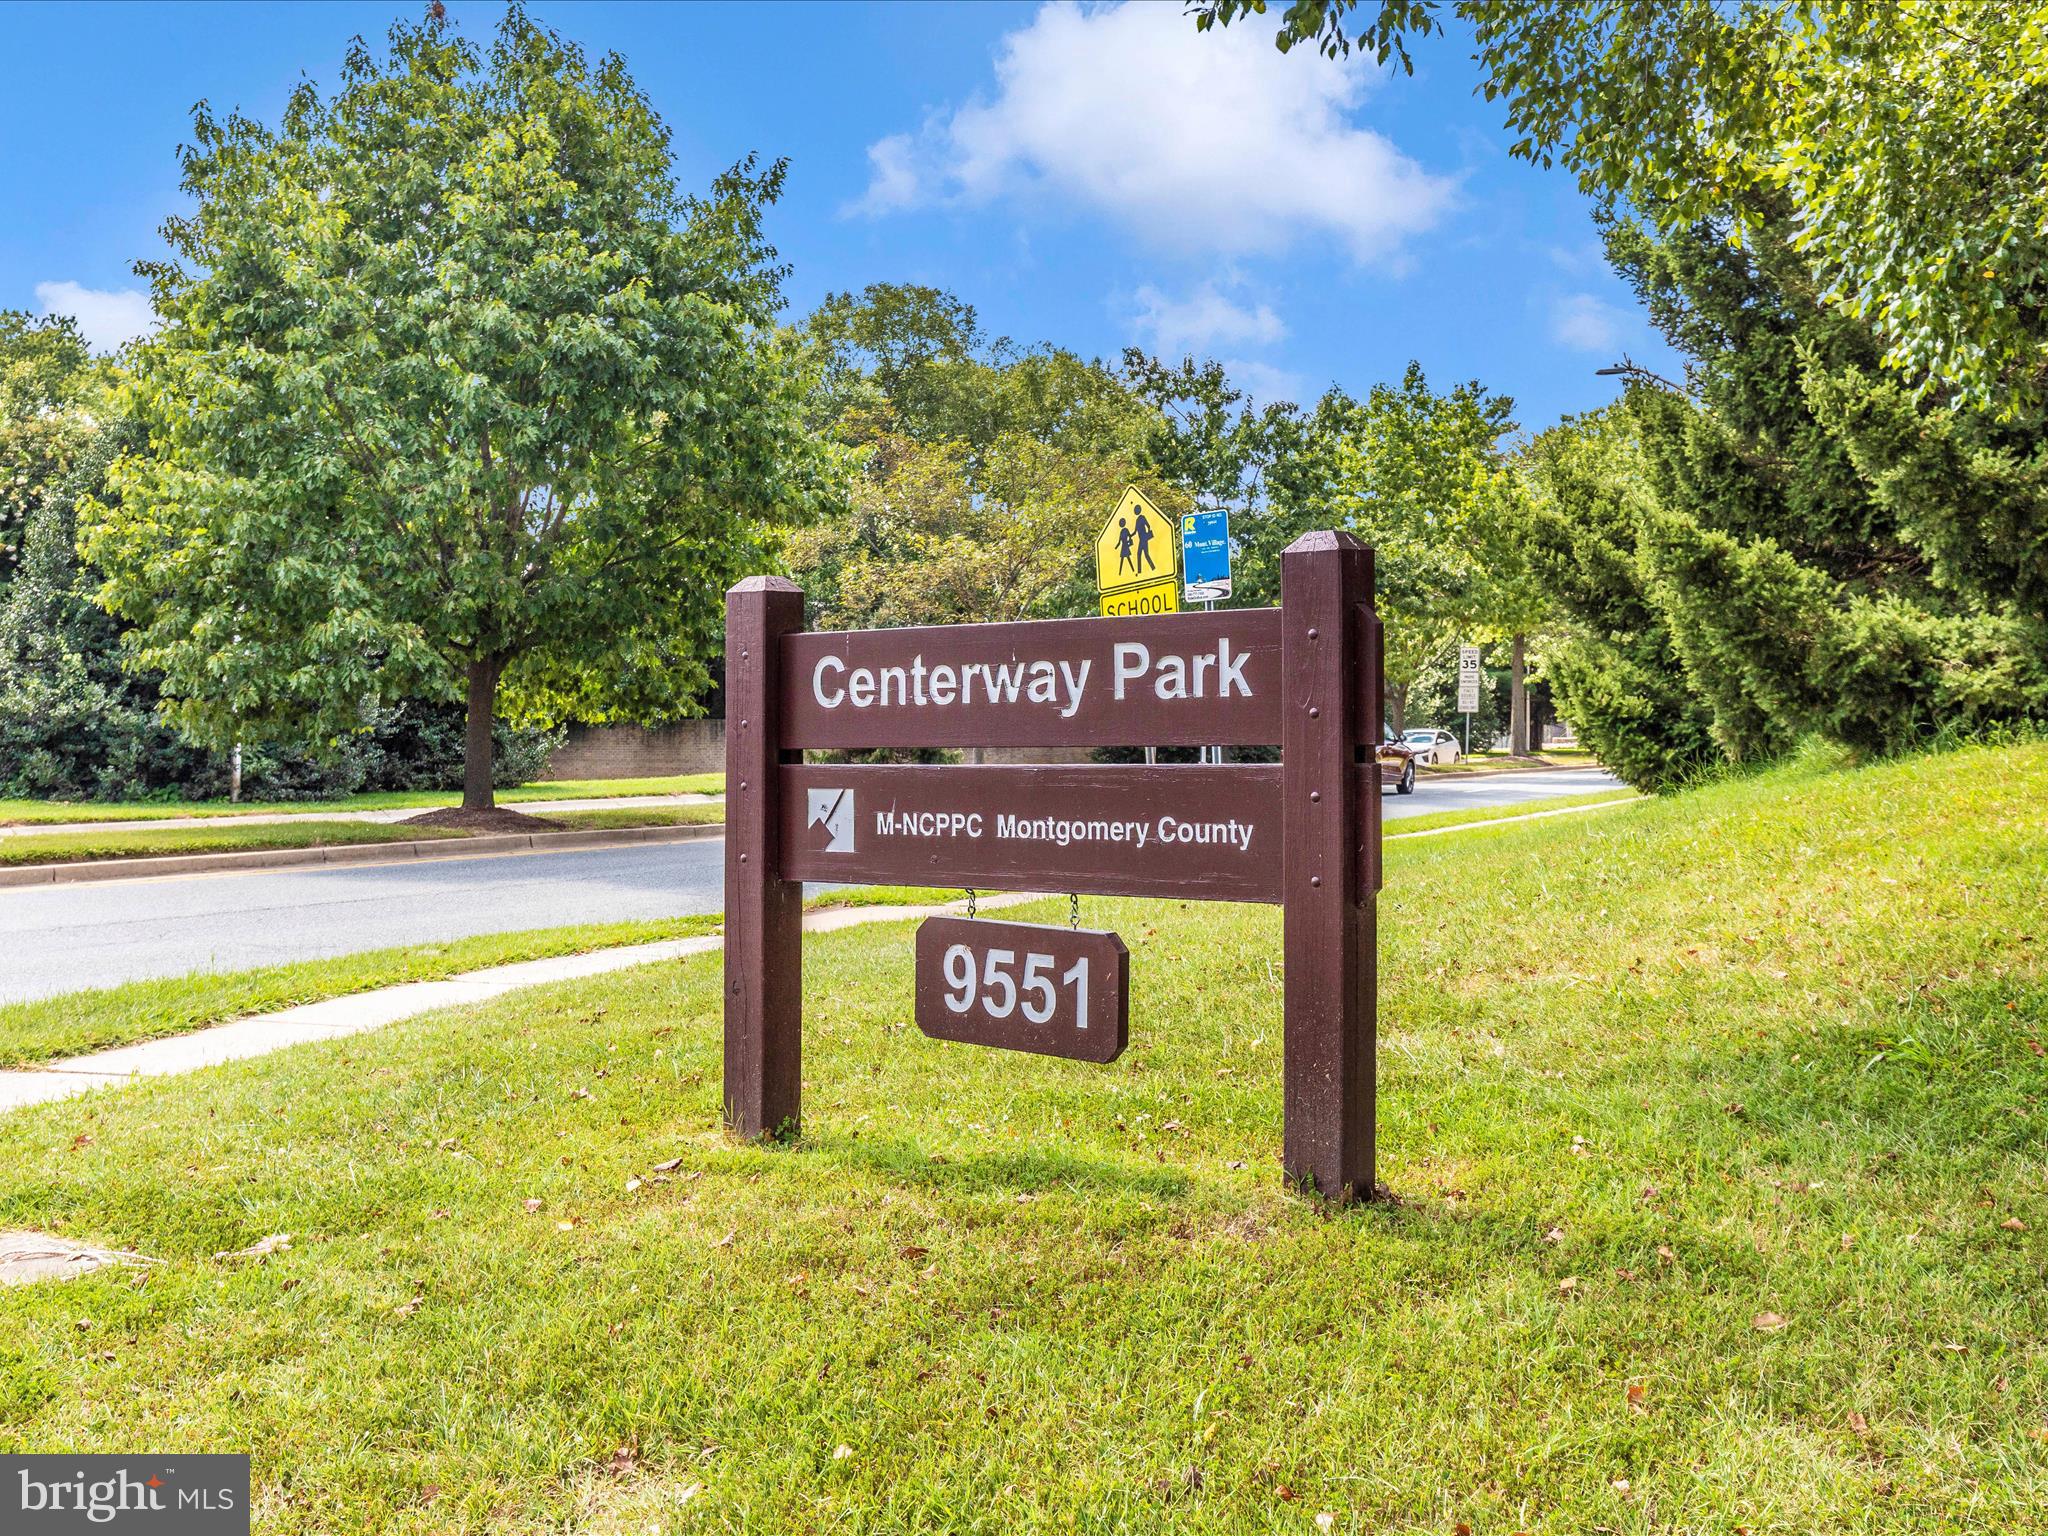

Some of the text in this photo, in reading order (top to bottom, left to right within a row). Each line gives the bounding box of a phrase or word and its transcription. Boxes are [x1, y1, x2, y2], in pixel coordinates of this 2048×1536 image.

[1184, 517, 1195, 531] R
[1107, 593, 1173, 616] SCHOOL
[812, 638, 1253, 719] Centerway Park
[1462, 660, 1477, 669] 35
[876, 812, 1254, 851] M-NCPPC Montgomery County
[943, 943, 1089, 1029] 9551
